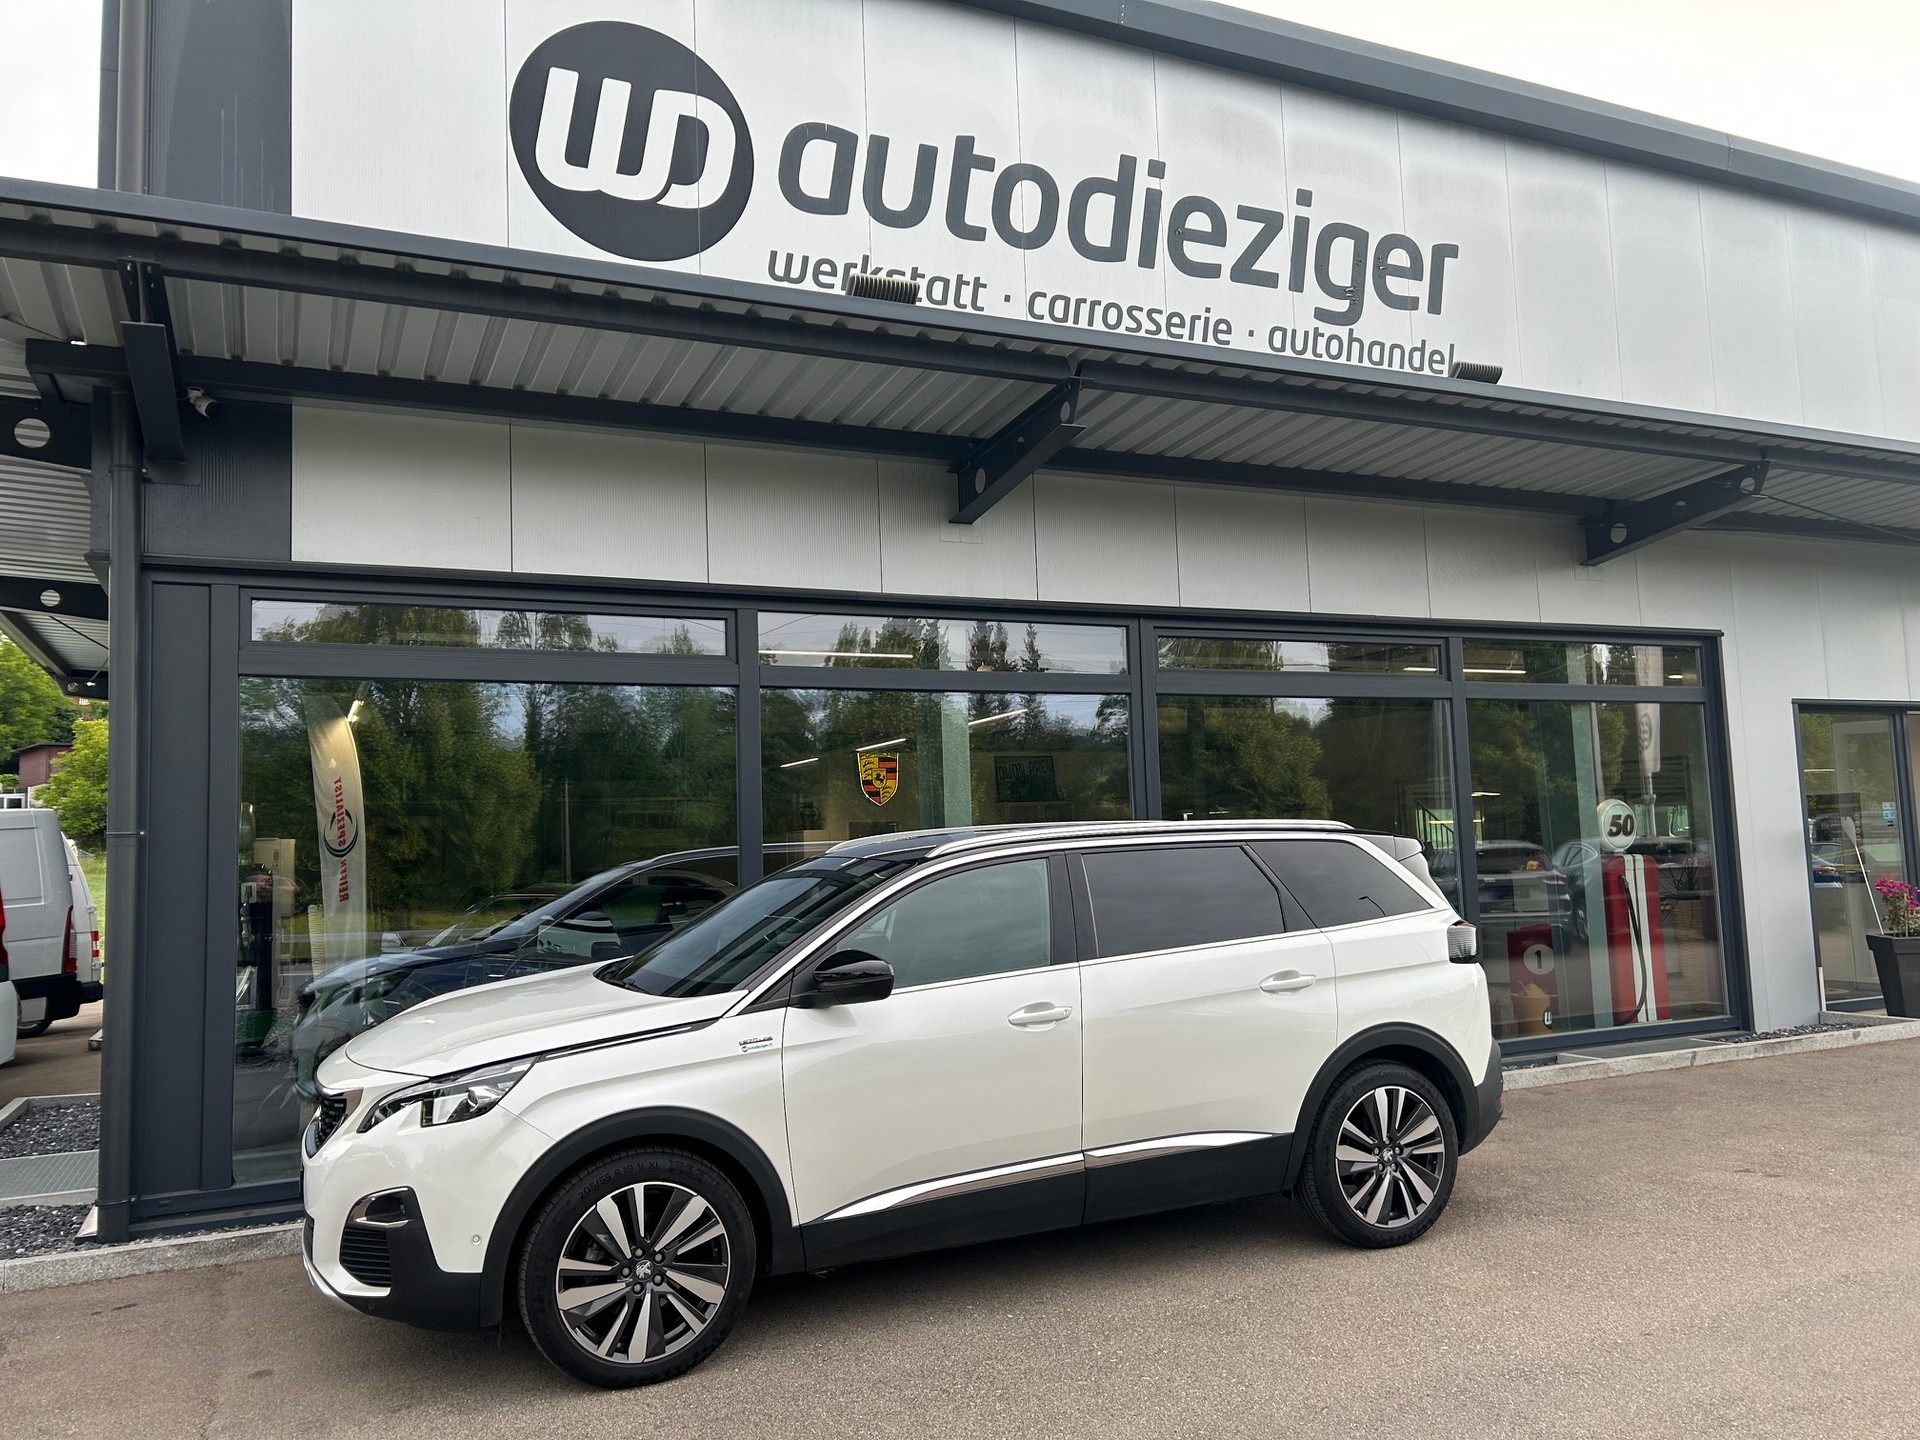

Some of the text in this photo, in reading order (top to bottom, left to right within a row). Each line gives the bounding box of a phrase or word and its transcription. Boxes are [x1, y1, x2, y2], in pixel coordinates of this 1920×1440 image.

[778, 122, 1460, 326] autodieziger
[768, 250, 1455, 377] wertatt carrosserie autohandel
[1607, 813, 1635, 837] 50
[1534, 949, 1543, 969] 1
[577, 1172, 612, 1200] 205/55
[648, 1160, 661, 1170] XL
